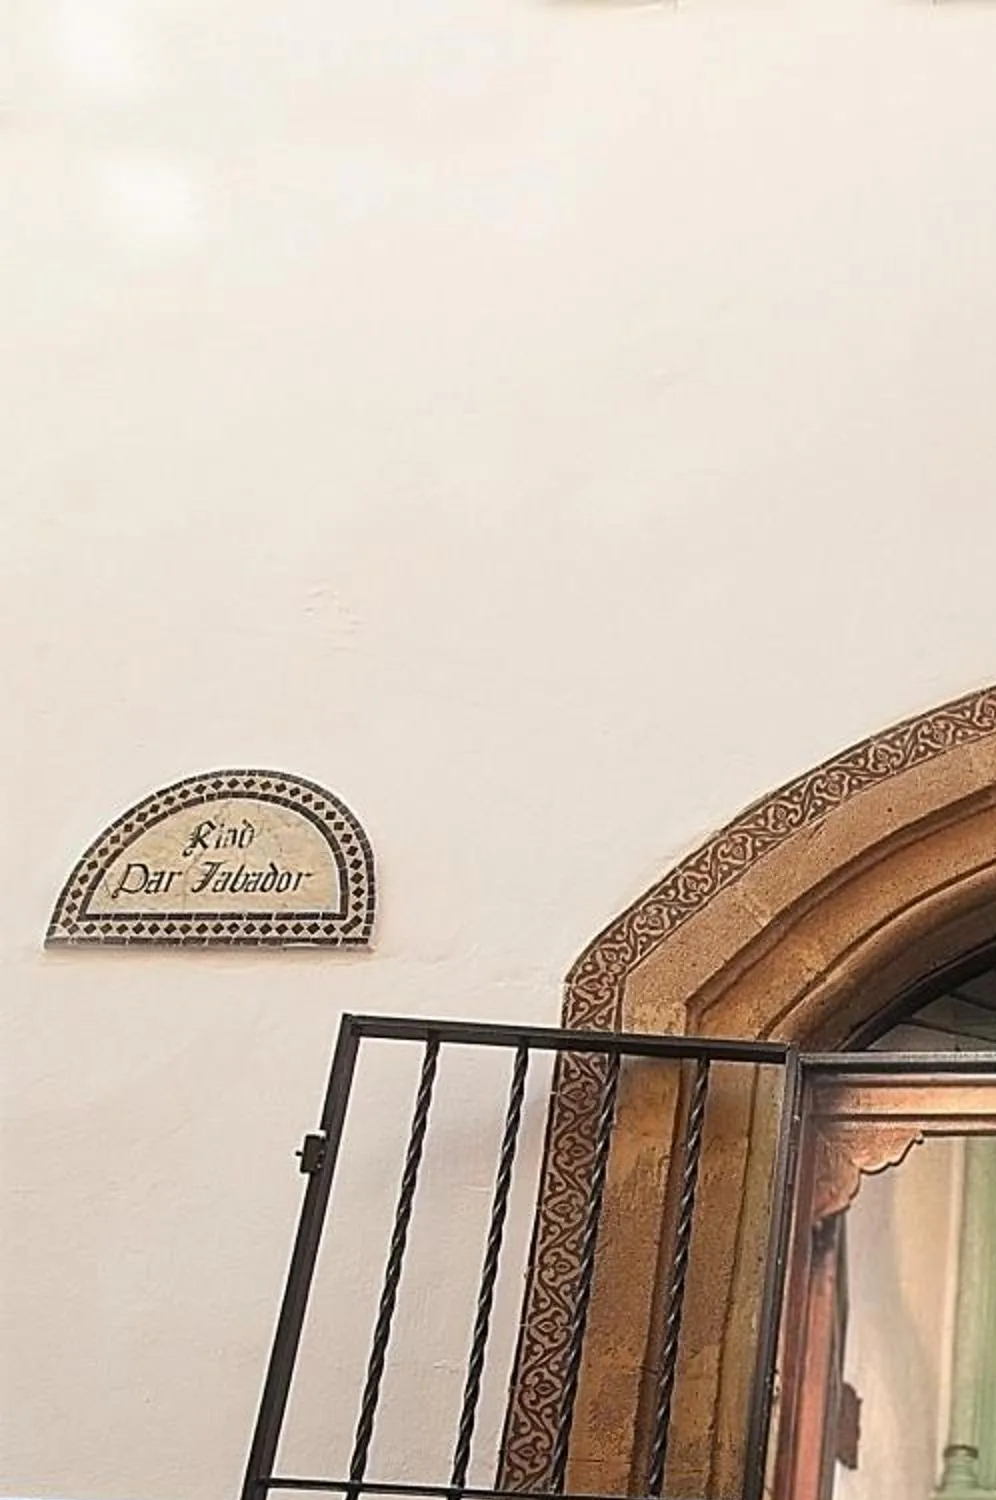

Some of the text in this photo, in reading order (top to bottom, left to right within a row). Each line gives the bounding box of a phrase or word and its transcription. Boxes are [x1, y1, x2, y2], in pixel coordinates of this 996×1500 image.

[182, 820, 255, 857] Riad
[111, 861, 313, 899] Dar Jabador
